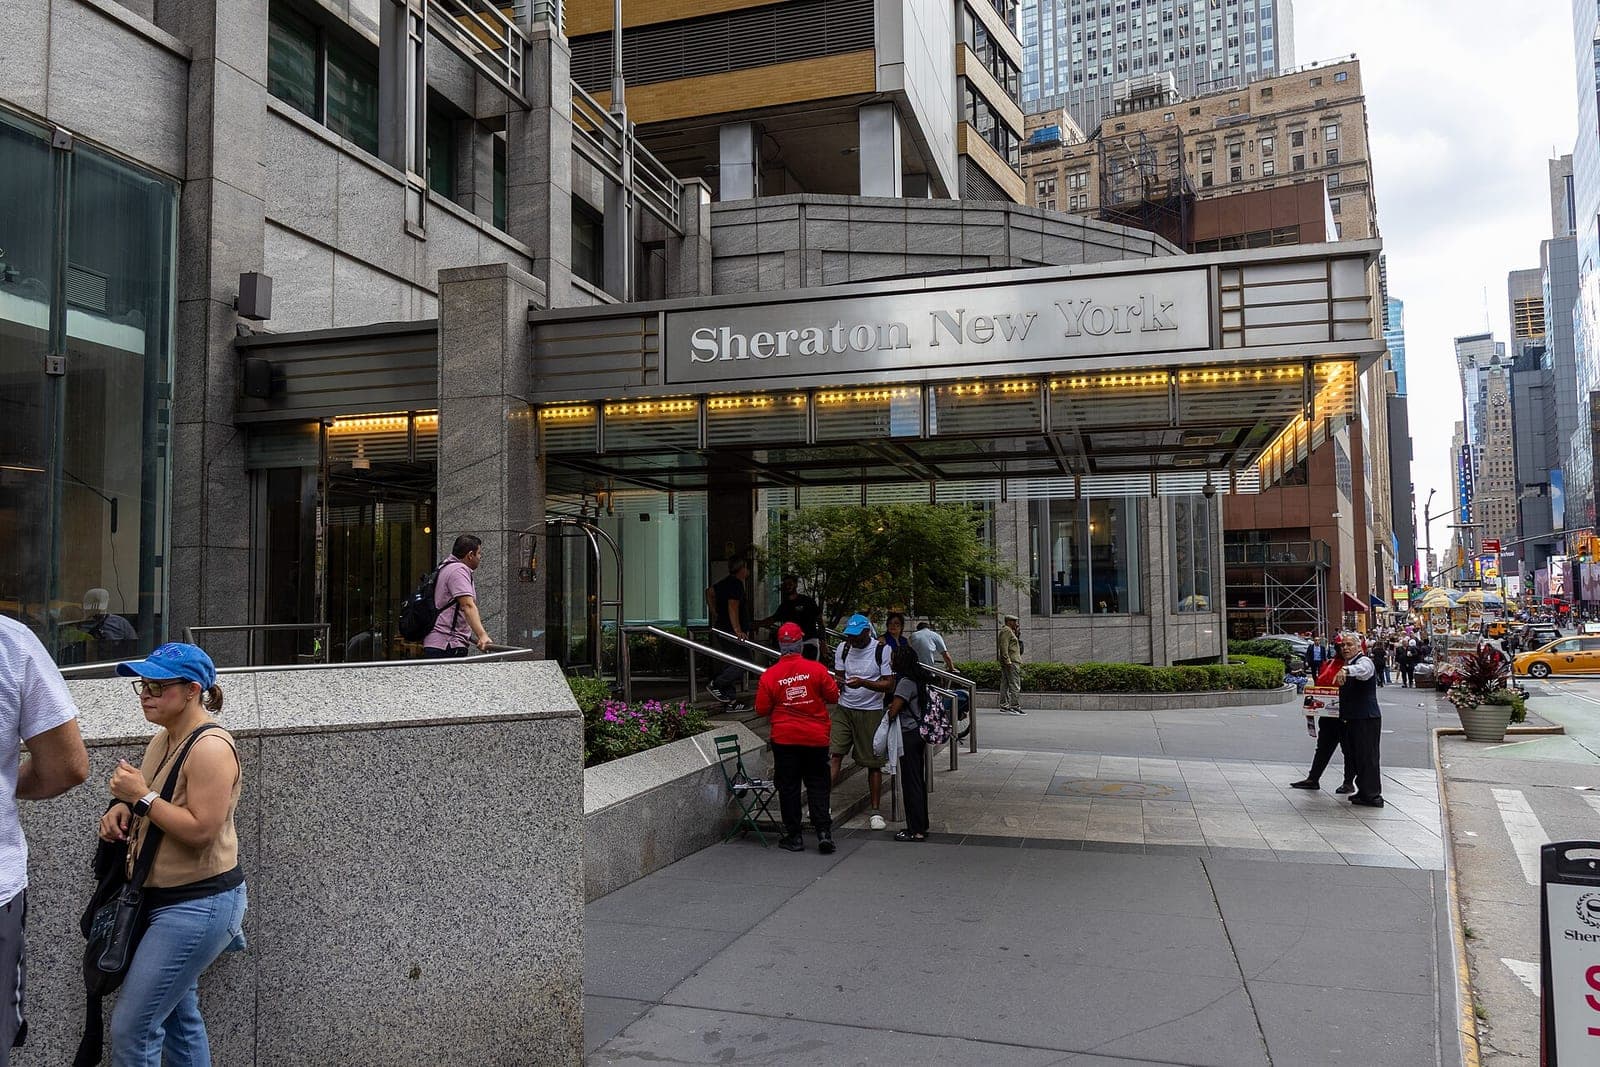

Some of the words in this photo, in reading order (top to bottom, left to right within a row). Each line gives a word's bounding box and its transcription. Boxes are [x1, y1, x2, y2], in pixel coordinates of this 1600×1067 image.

[691, 319, 911, 363] Sheraton
[929, 308, 1037, 347] New
[1054, 294, 1178, 337] York
